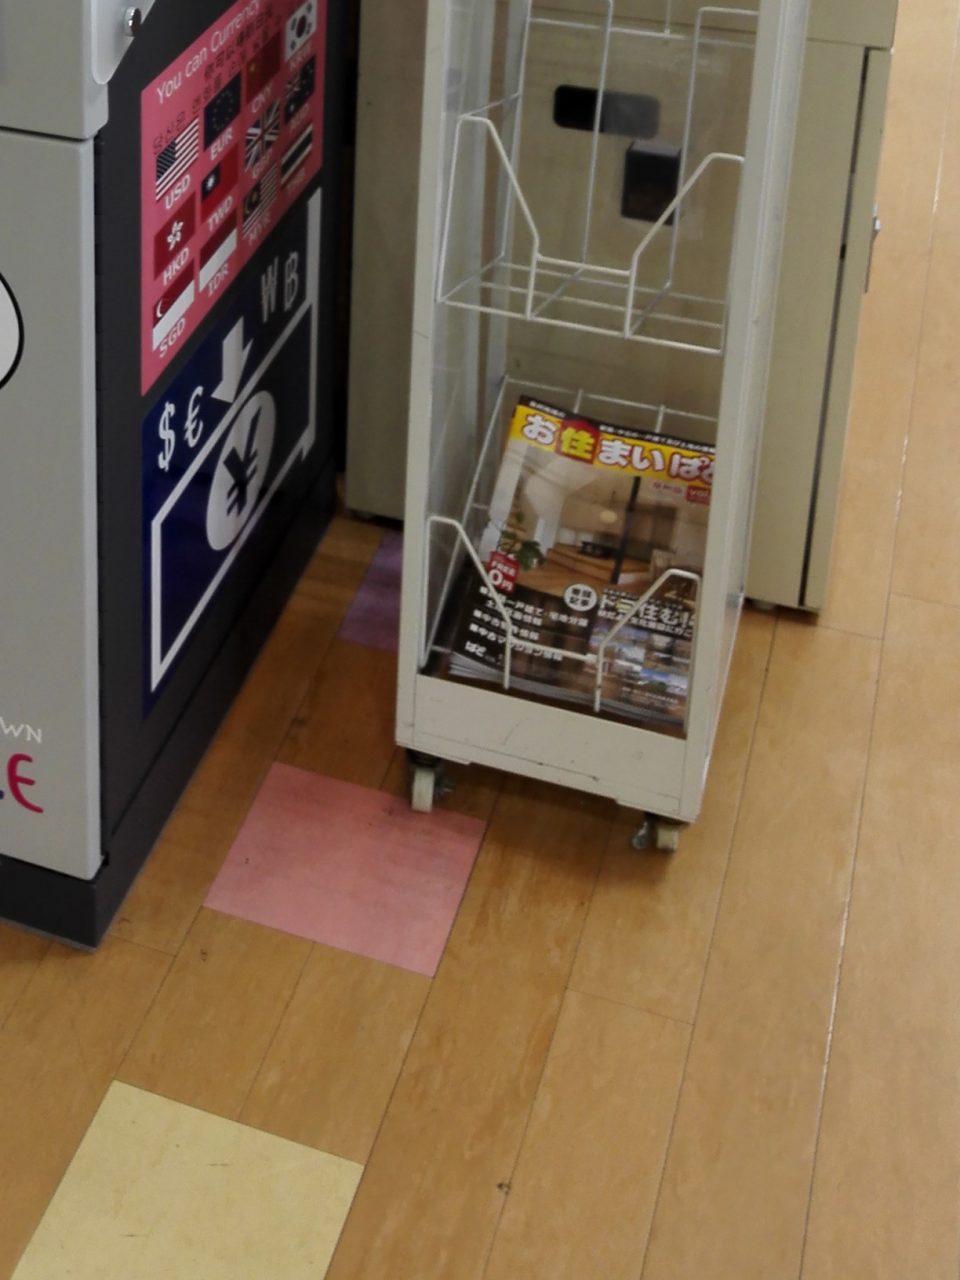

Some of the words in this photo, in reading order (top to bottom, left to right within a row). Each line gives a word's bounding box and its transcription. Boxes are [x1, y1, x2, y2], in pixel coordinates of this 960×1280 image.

[155, 76, 183, 106] You
[184, 47, 209, 78] can
[210, 127, 234, 161] EUR
[164, 174, 191, 210] USD
[208, 195, 234, 232] TWD
[162, 246, 190, 287] HKD
[208, 262, 230, 297] IDR
[158, 317, 186, 359] SGD
